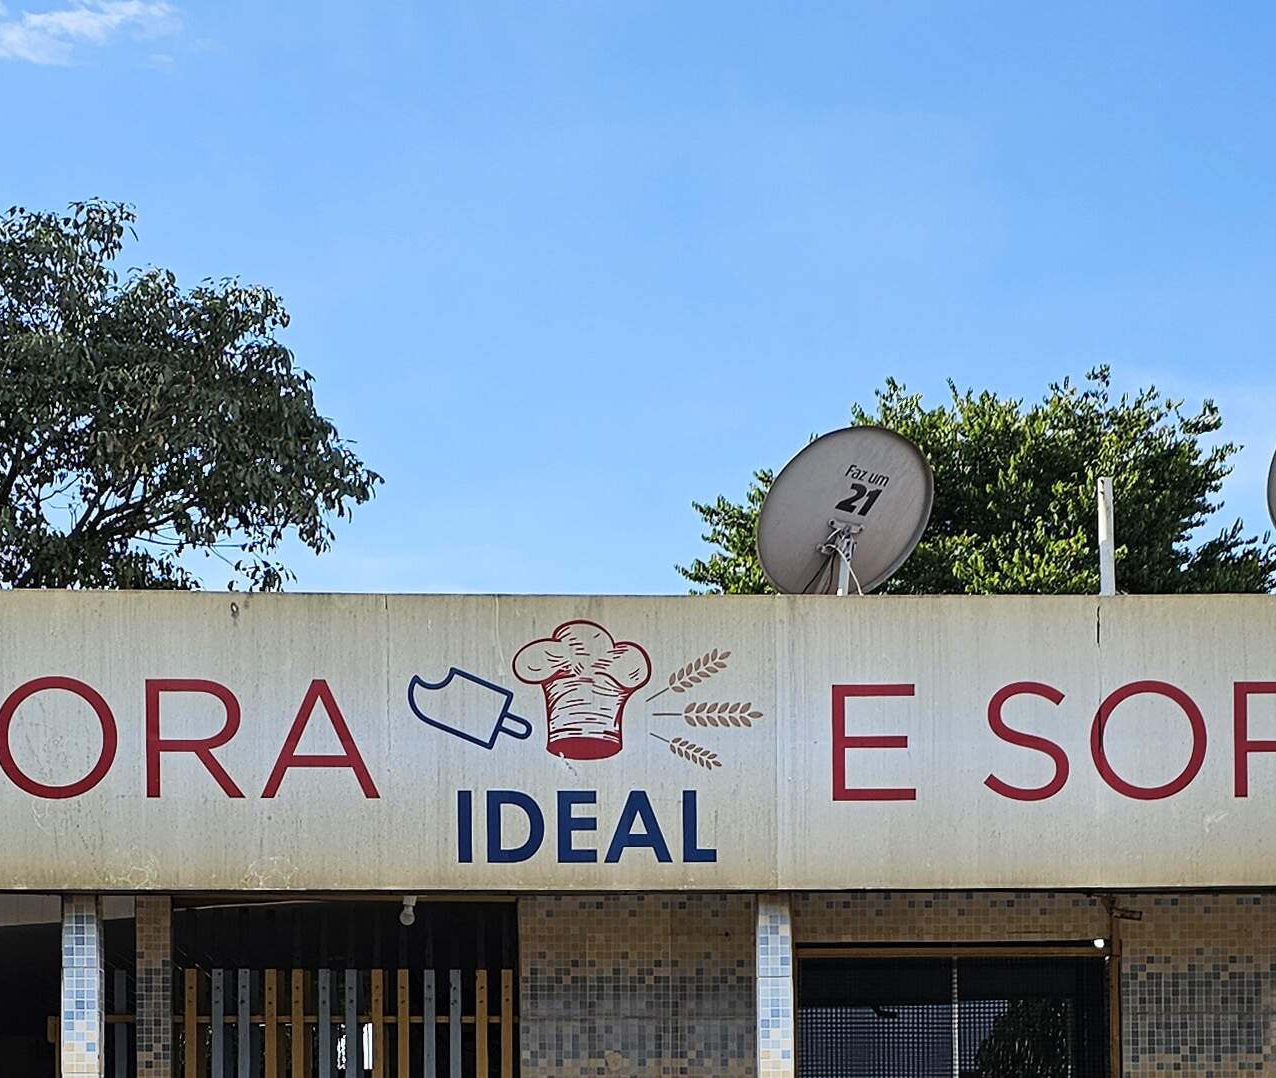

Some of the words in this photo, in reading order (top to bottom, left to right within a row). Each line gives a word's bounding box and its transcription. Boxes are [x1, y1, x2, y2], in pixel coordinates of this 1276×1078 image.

[835, 483, 883, 516] 21
[845, 464, 868, 481] Faz
[868, 472, 890, 487] um
[831, 683, 917, 802] E
[457, 790, 717, 863] IDEAL
